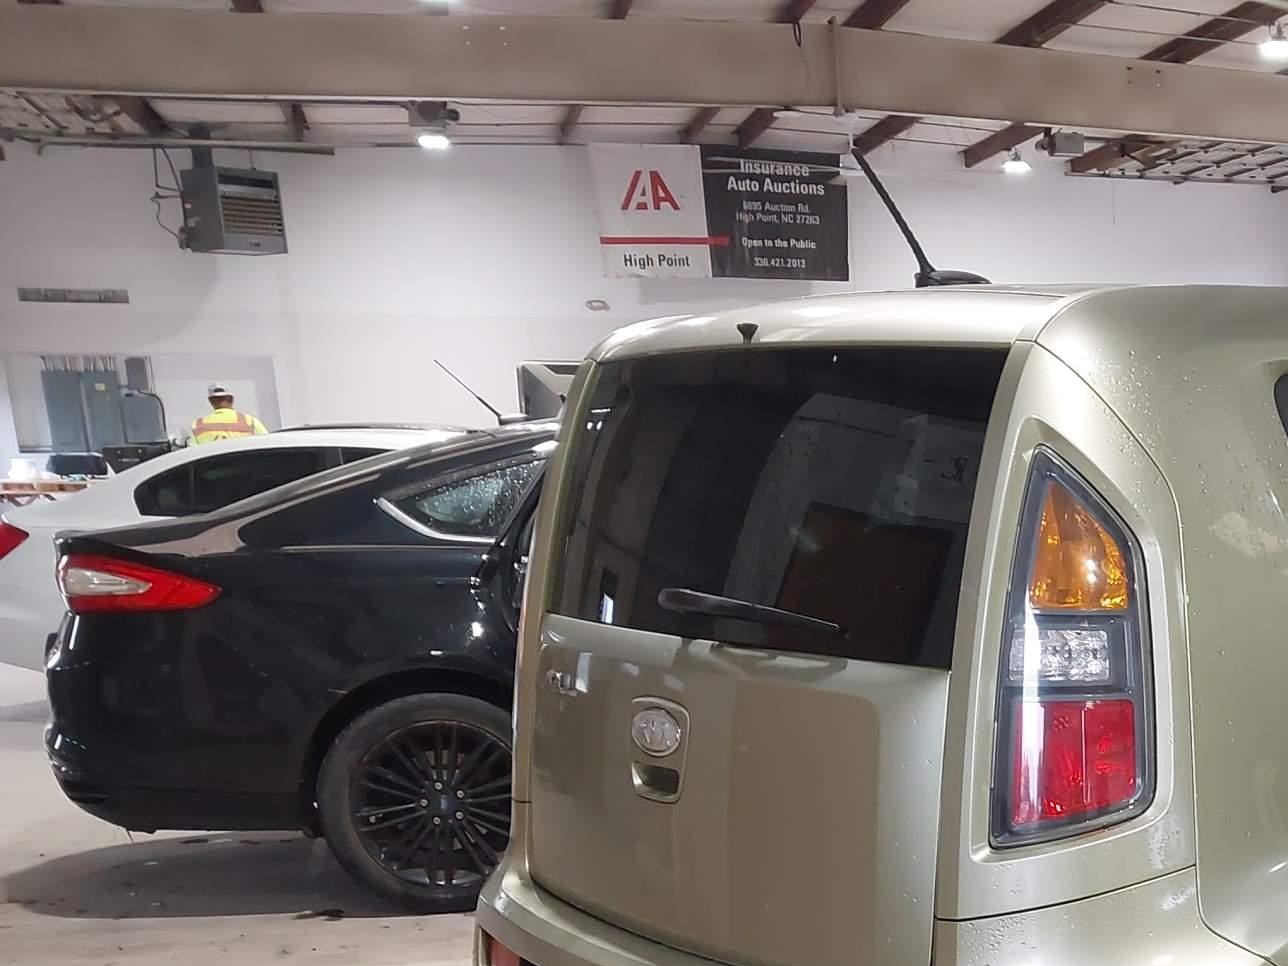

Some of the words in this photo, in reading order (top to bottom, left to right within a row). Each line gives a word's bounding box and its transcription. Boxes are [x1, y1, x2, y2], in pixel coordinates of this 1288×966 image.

[740, 159, 809, 176] Insurance
[727, 176, 759, 192] Auto
[763, 178, 825, 196] Auctions
[764, 202, 796, 213] Auction
[736, 212, 754, 224] High
[781, 214, 794, 224] NC
[741, 237, 762, 249] Open
[764, 239, 773, 248] to
[775, 238, 788, 248] the
[789, 239, 817, 249] Public
[623, 254, 654, 270] High
[657, 254, 691, 268] Point
